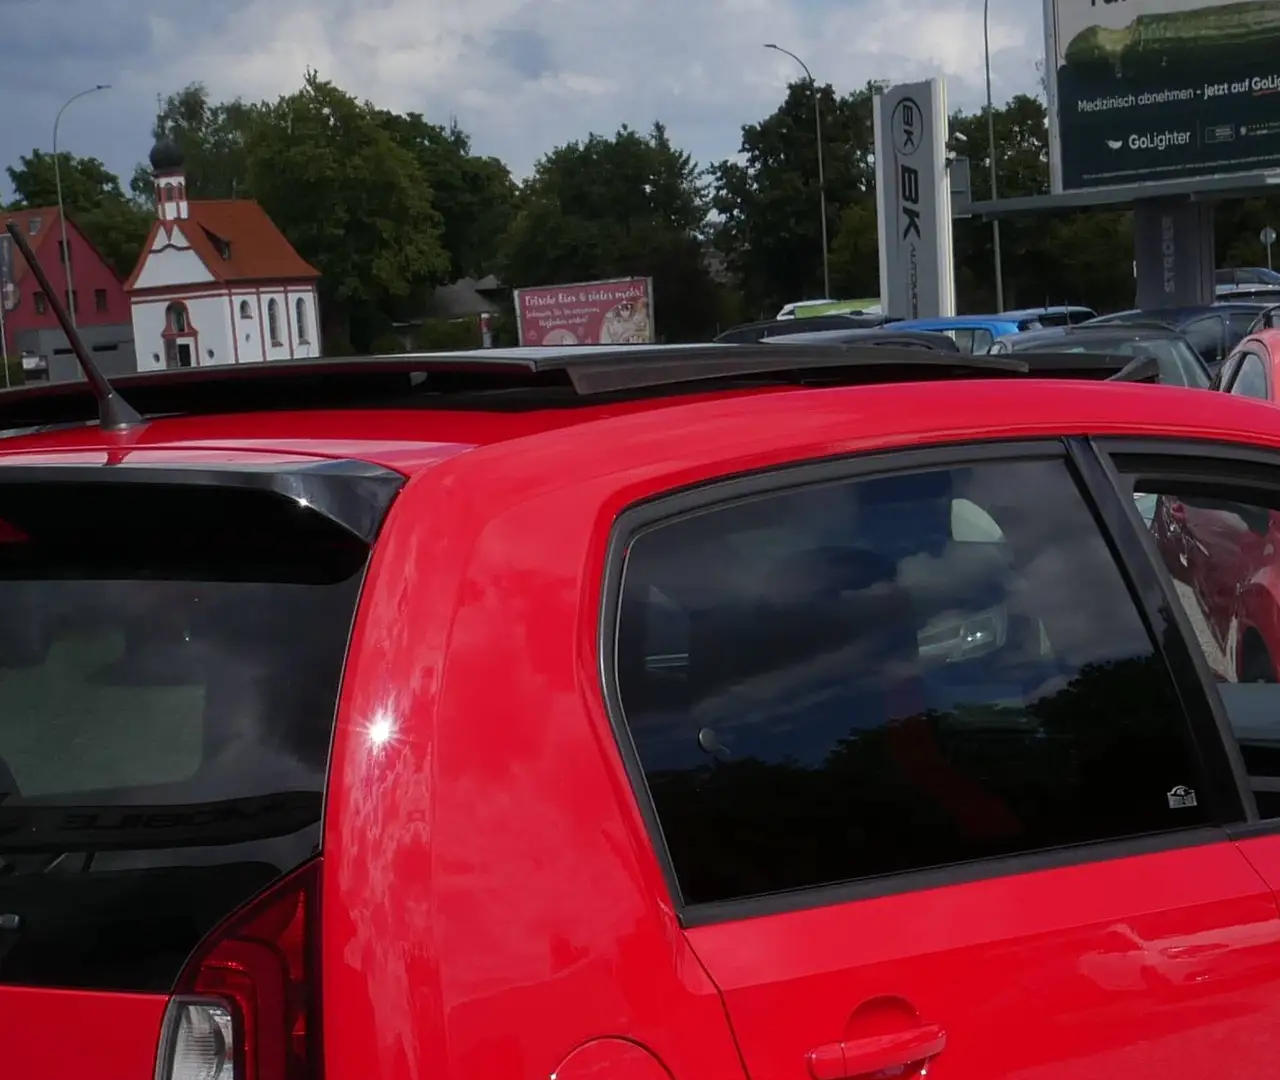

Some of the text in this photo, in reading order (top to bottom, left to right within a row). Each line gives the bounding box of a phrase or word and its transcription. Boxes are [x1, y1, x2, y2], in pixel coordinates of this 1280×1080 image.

[1078, 93, 1136, 112] Medizinisch
[1137, 88, 1194, 105] abnehmen
[1203, 82, 1228, 100] jetzt
[1231, 78, 1249, 94] auf
[902, 103, 915, 149] BK
[1128, 130, 1191, 150] GoLighter
[901, 164, 921, 241] BK
